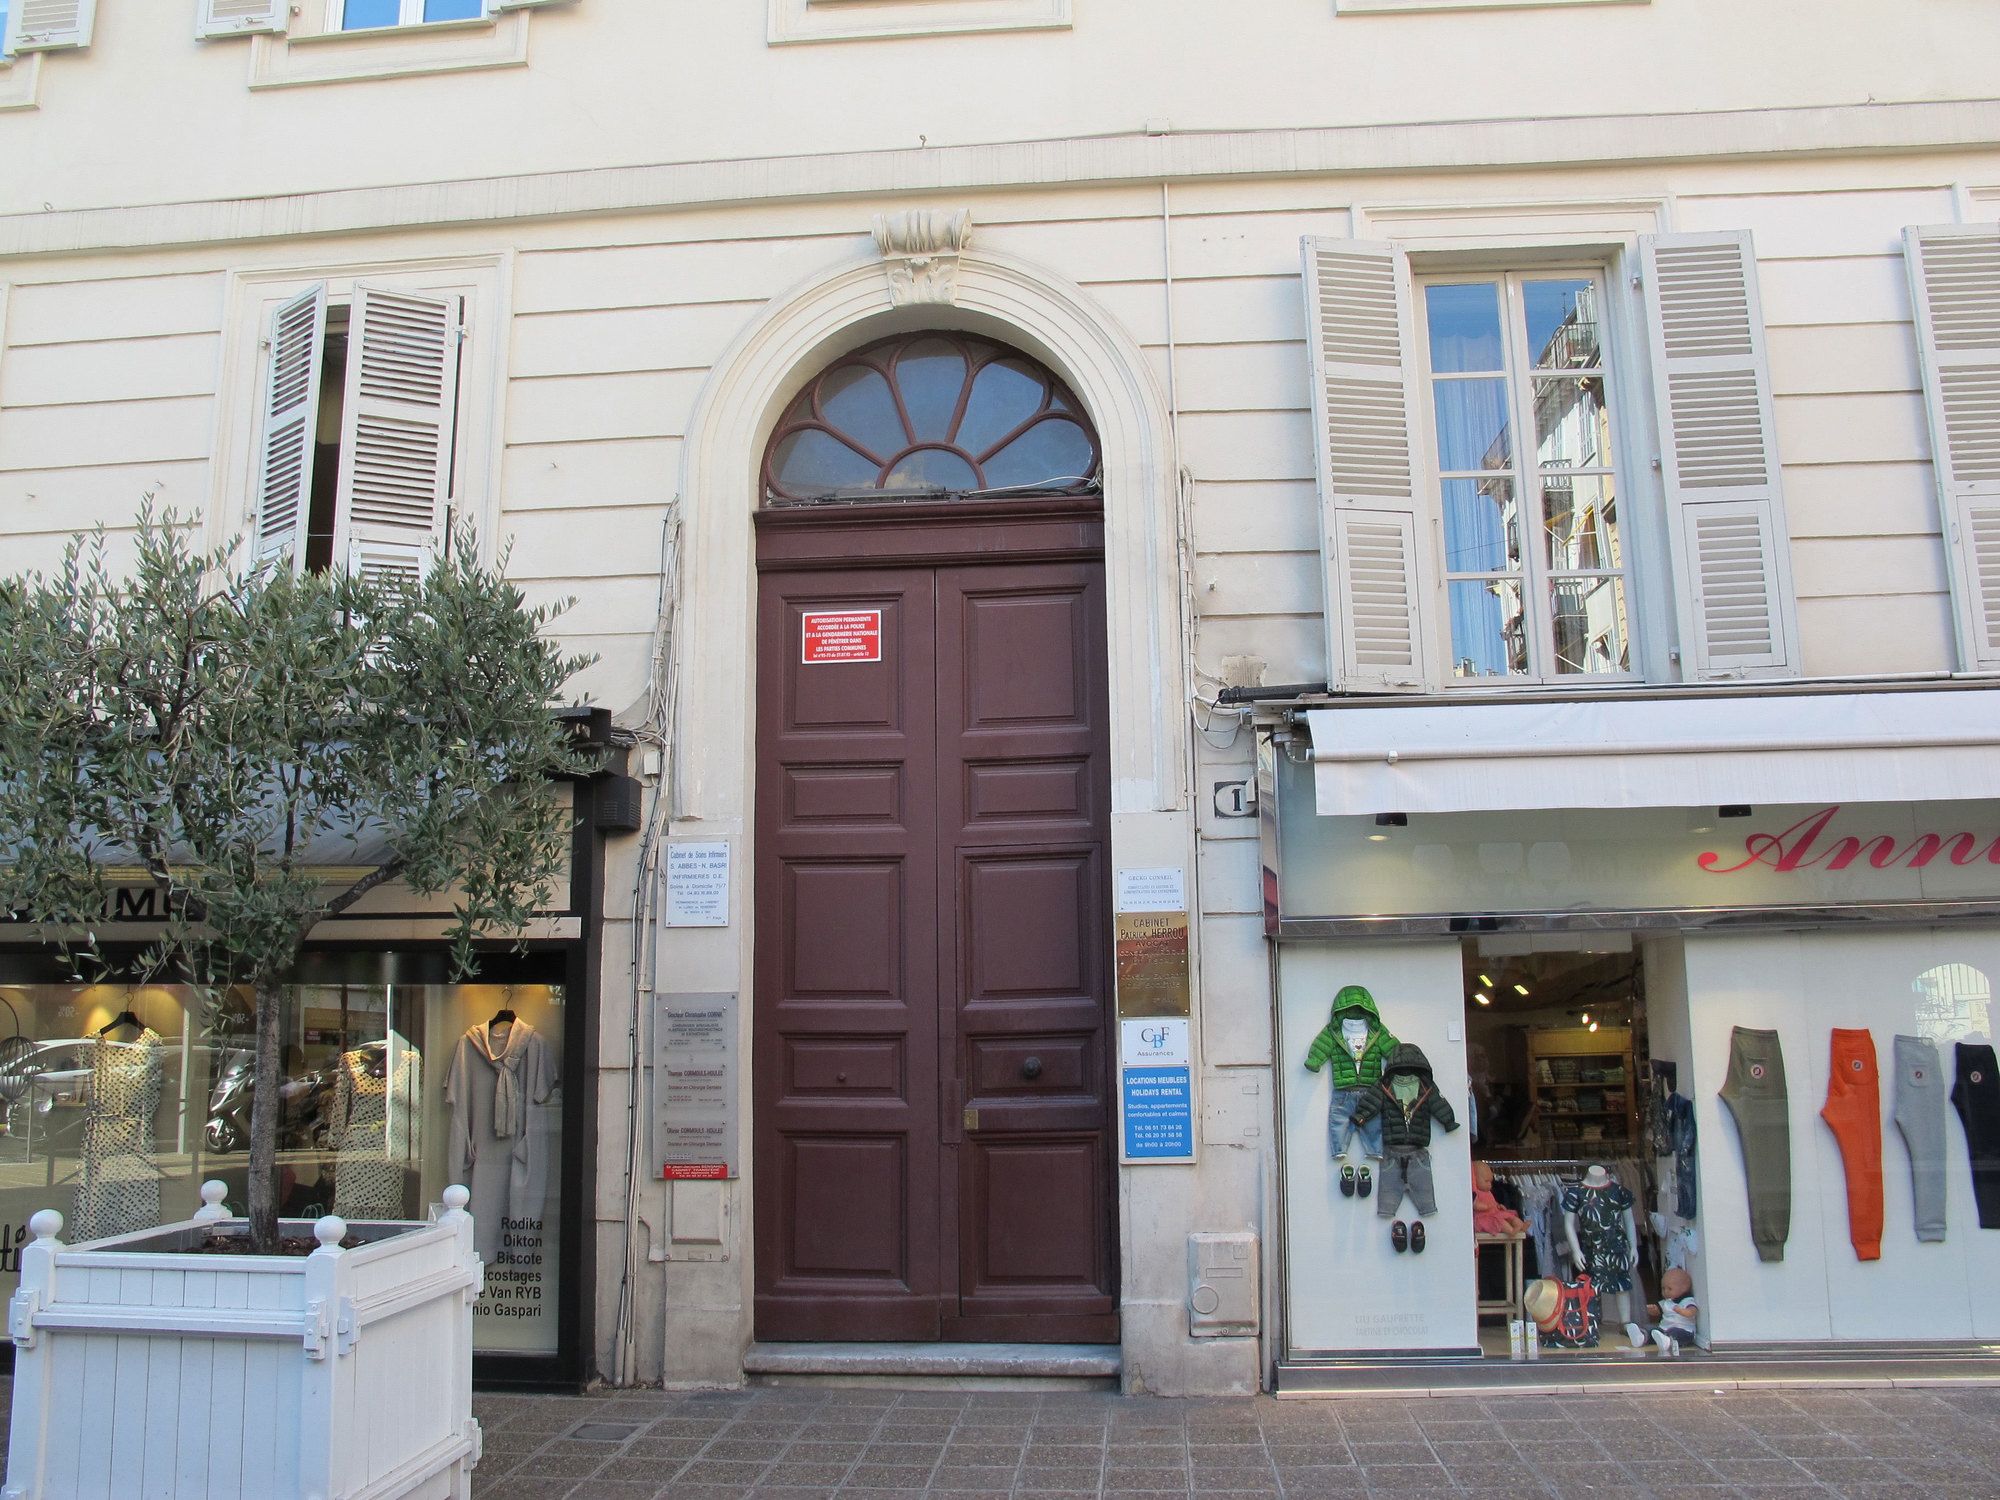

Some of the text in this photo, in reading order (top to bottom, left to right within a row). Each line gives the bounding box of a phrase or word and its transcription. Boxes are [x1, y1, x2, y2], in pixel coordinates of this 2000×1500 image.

[1232, 788, 1242, 811] 1
[1697, 805, 2000, 873] Ann
[1134, 918, 1169, 928] CABINET
[1152, 928, 1184, 939] HERROU
[501, 1217, 542, 1230] Rodika
[504, 1234, 542, 1247] Dikton
[497, 1252, 542, 1264] Biscote
[484, 1270, 542, 1285] costages
[490, 1286, 511, 1298] Van
[516, 1286, 542, 1299] RYB
[473, 1303, 541, 1318] nio Gaspari
